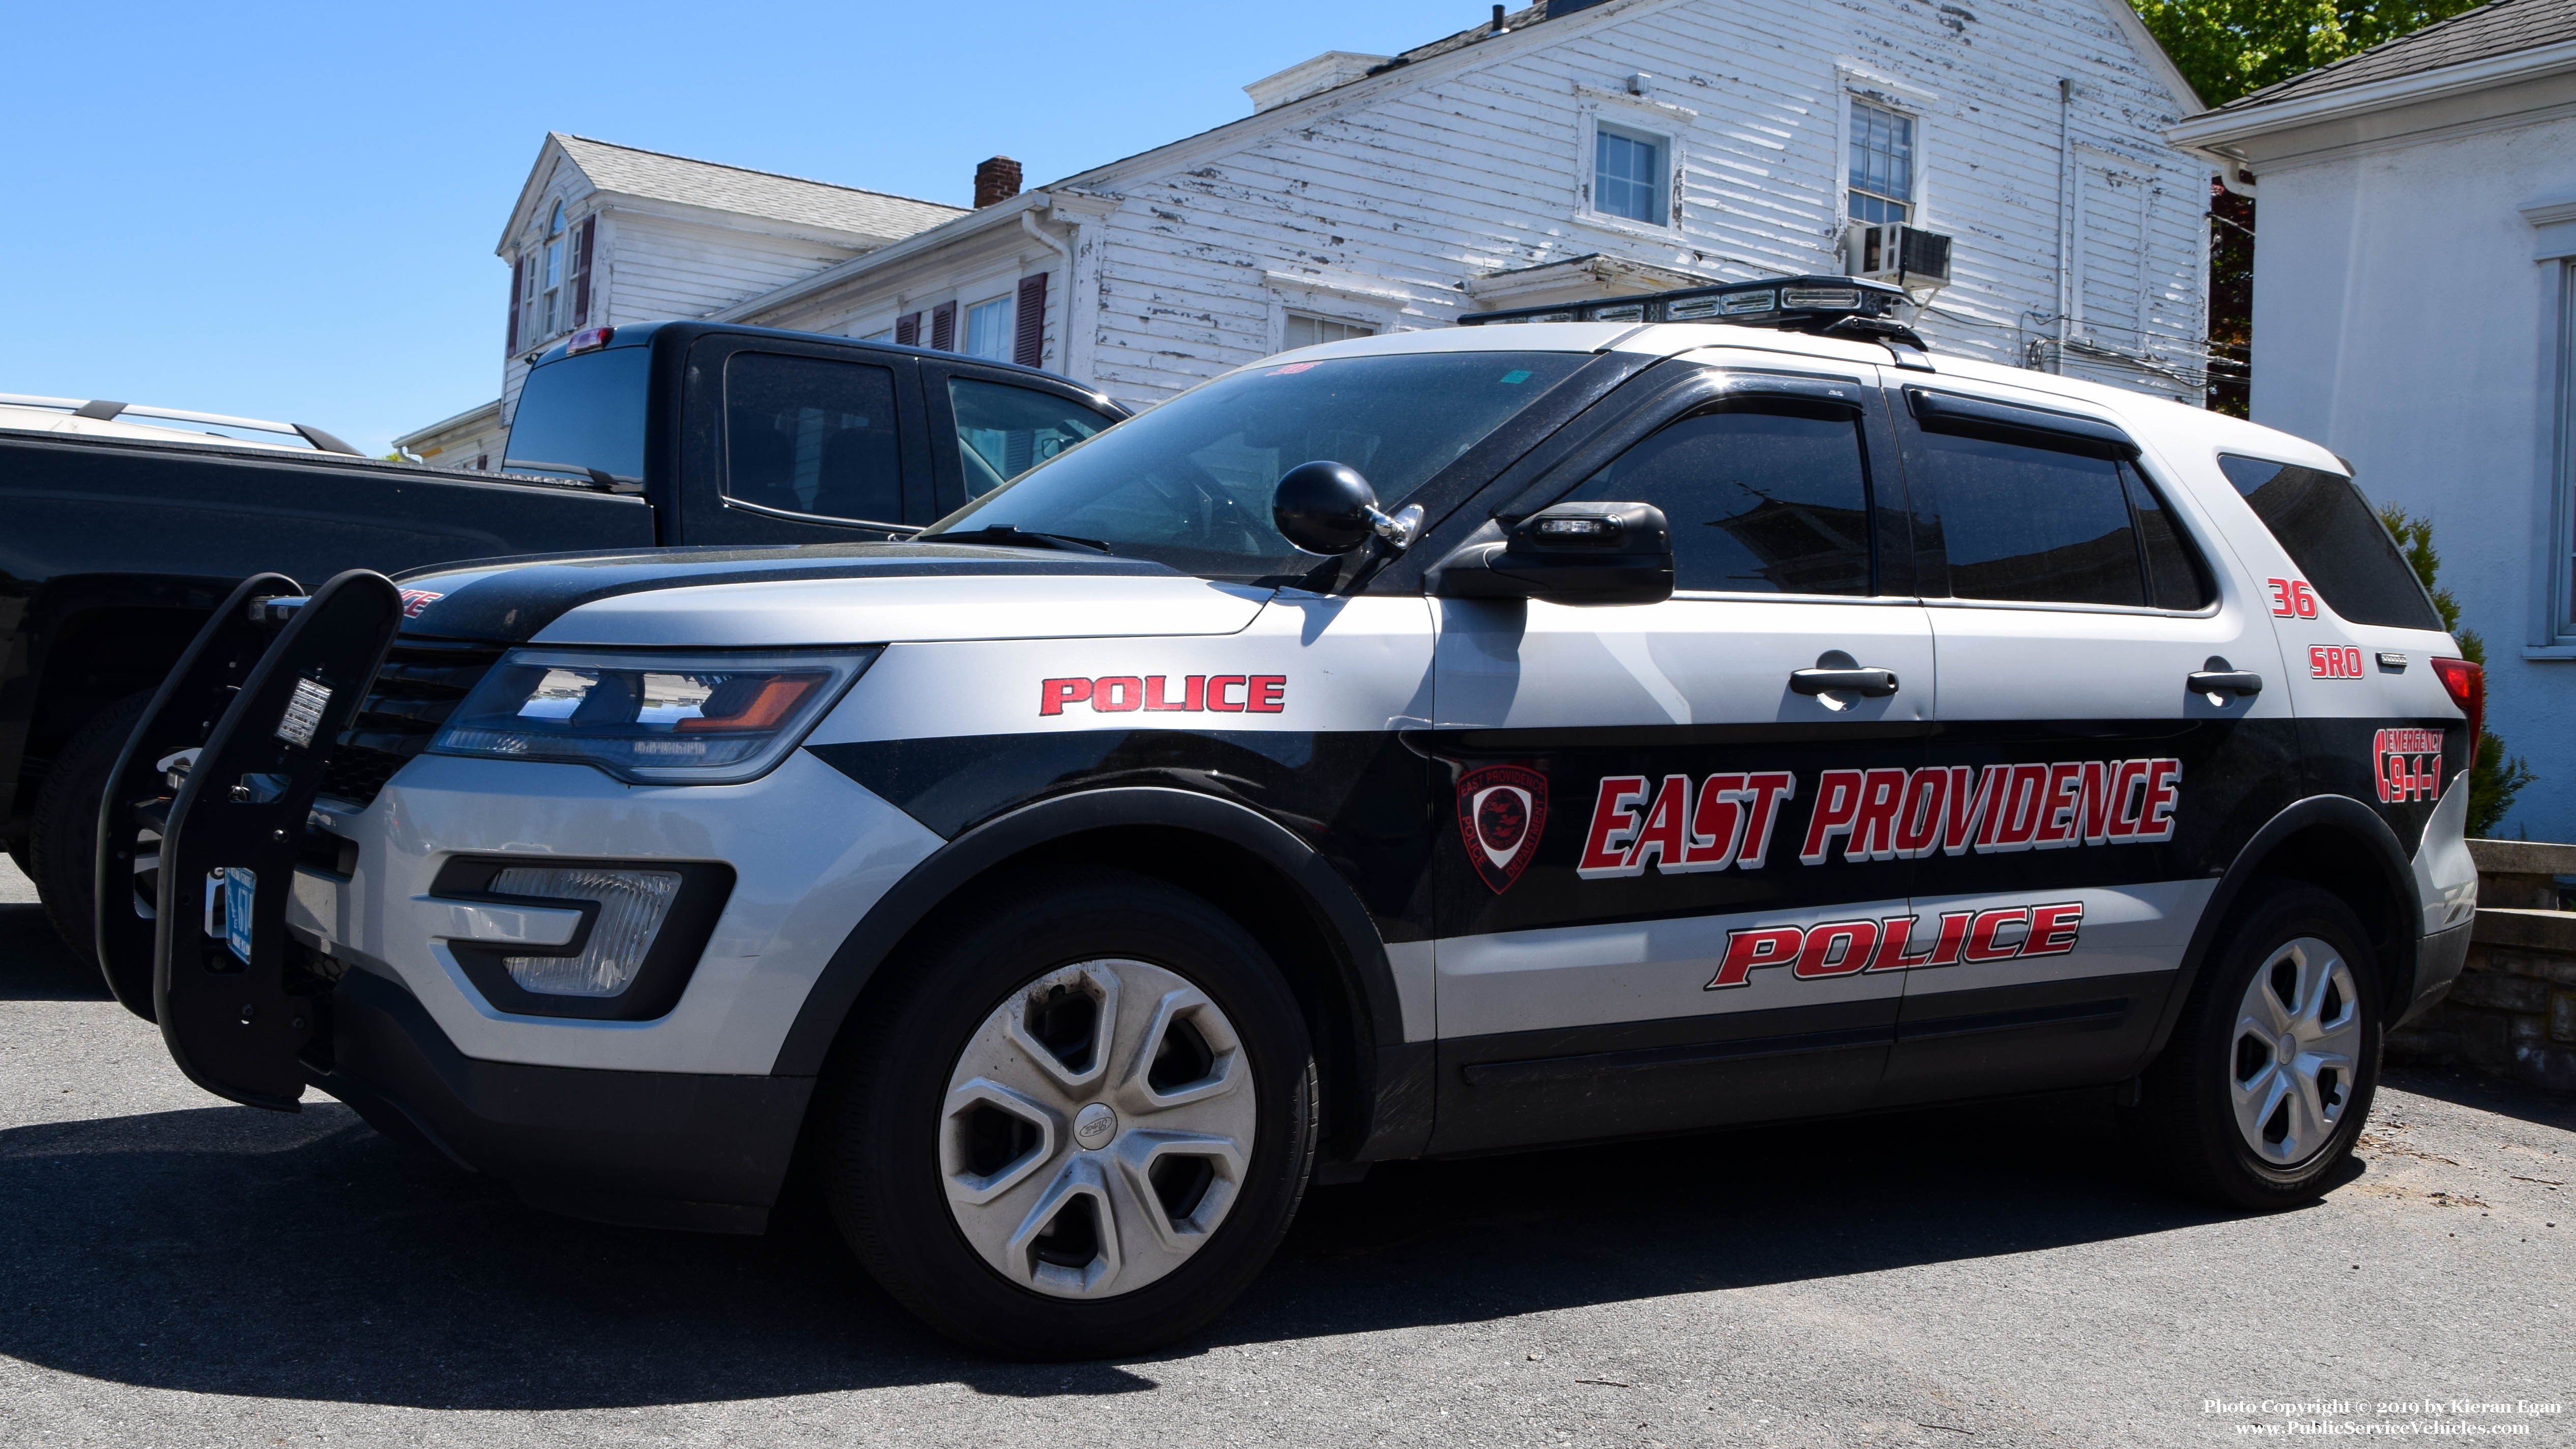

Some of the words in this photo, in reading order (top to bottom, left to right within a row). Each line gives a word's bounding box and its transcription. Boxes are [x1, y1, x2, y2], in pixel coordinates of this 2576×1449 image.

[2267, 577, 2318, 619] 36
[2308, 644, 2365, 680] SRO
[1038, 675, 1286, 717] POLICE
[2386, 728, 2445, 754] EMERGENCY
[1461, 774, 1484, 797] EAST
[1486, 770, 1545, 794] PROVIDENCE
[2389, 754, 2442, 803] 9-1-1
[1461, 815, 1487, 867] POLICE
[1505, 799, 1544, 878] DEPARTMENT
[1577, 771, 1797, 880] EAST
[1799, 758, 2182, 866] PROVIDENCE
[1703, 900, 2084, 991] POLICE
